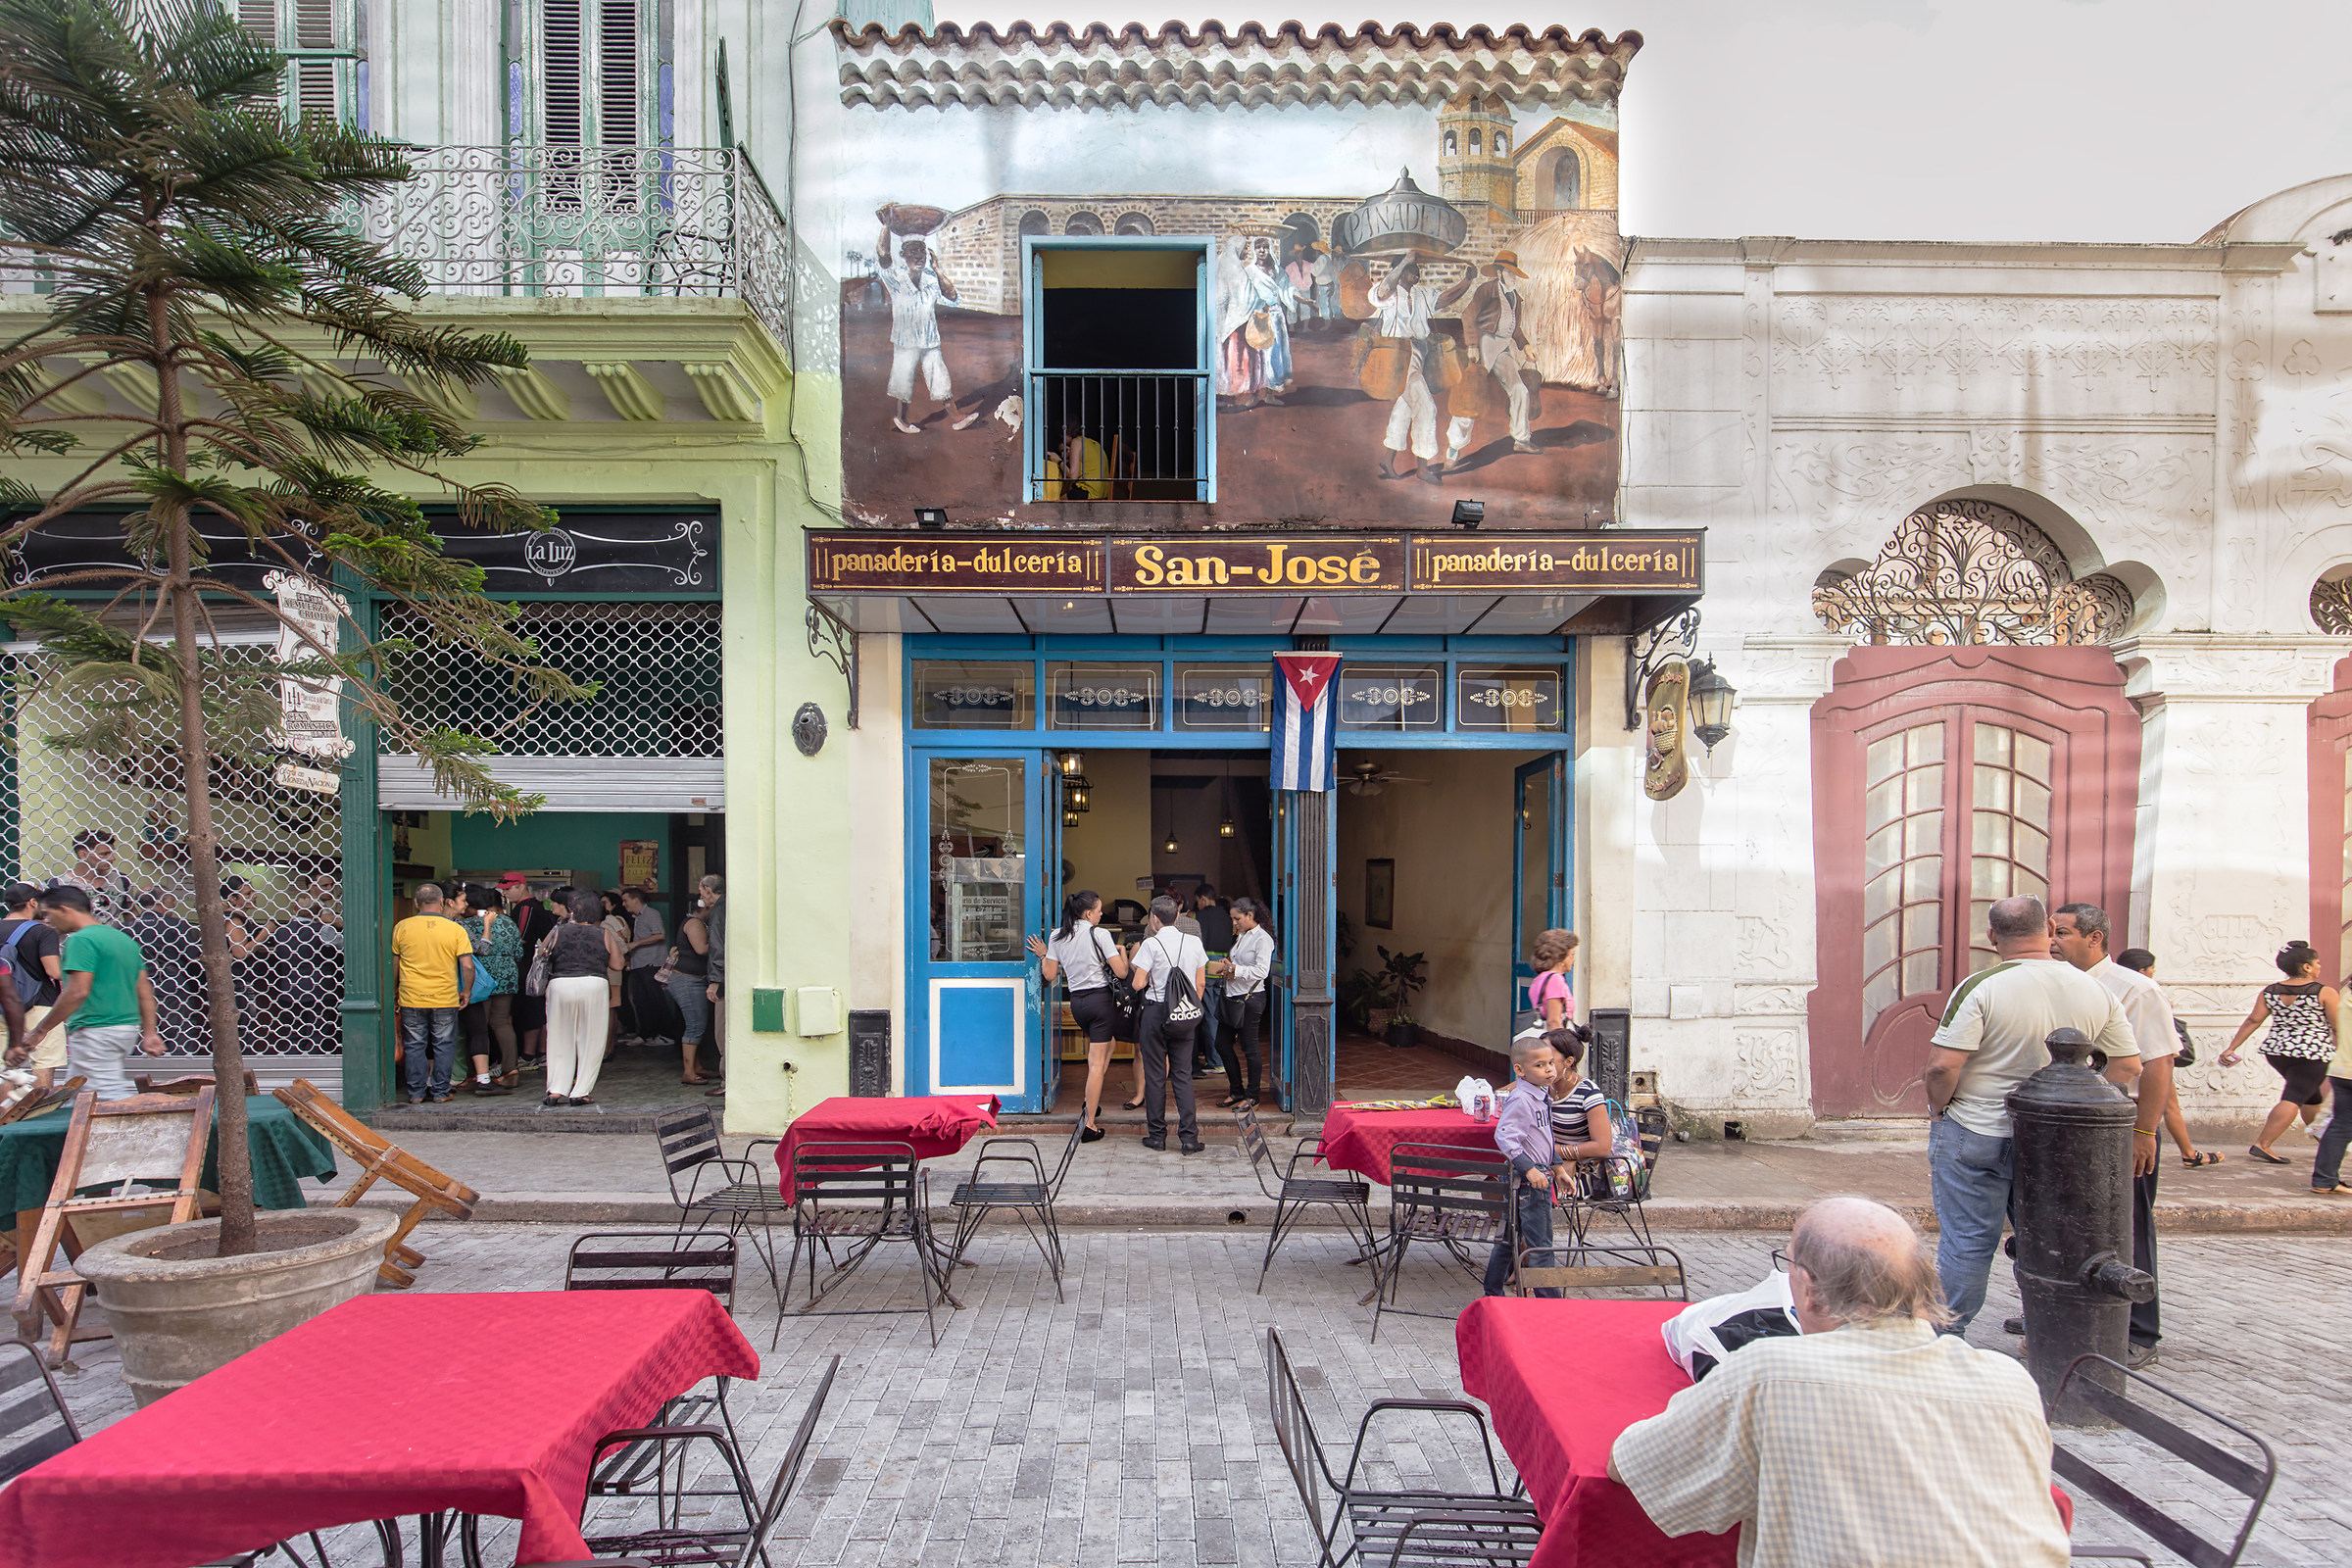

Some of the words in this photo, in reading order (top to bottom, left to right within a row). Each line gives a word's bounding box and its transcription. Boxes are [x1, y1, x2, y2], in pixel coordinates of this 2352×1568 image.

[527, 545, 547, 560] La
[547, 541, 574, 563] Luz
[832, 546, 1083, 581] panadería-dulcería
[1135, 544, 1381, 585] San-José
[1432, 545, 1679, 582] panadería-dulcería
[287, 712, 310, 721] CENA
[625, 856, 653, 864] FELIZ
[1170, 1008, 1201, 1020] adidas
